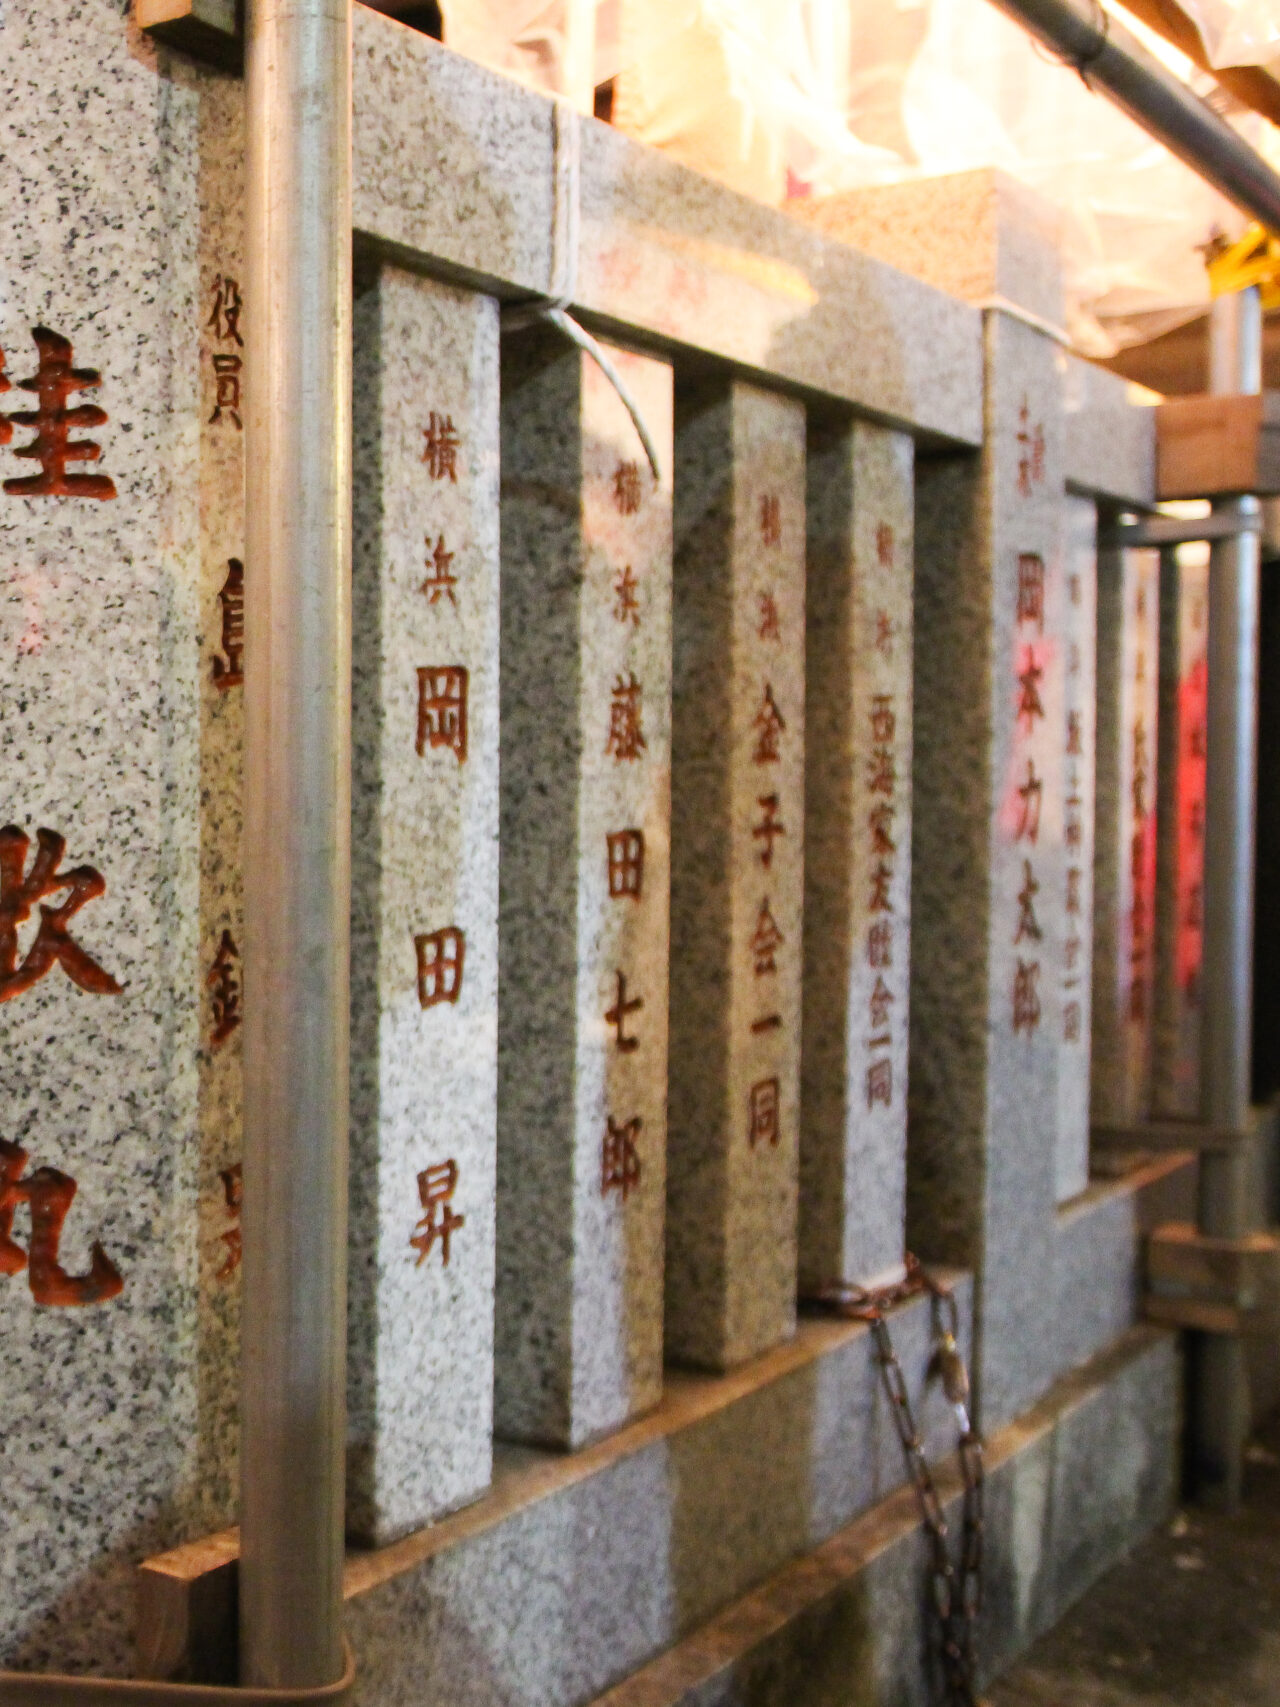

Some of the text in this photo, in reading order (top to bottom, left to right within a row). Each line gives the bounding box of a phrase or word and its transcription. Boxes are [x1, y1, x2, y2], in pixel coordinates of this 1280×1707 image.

[409, 409, 470, 1268] 横浜岡田昇
[600, 458, 648, 1203] 横浜藤田七郎
